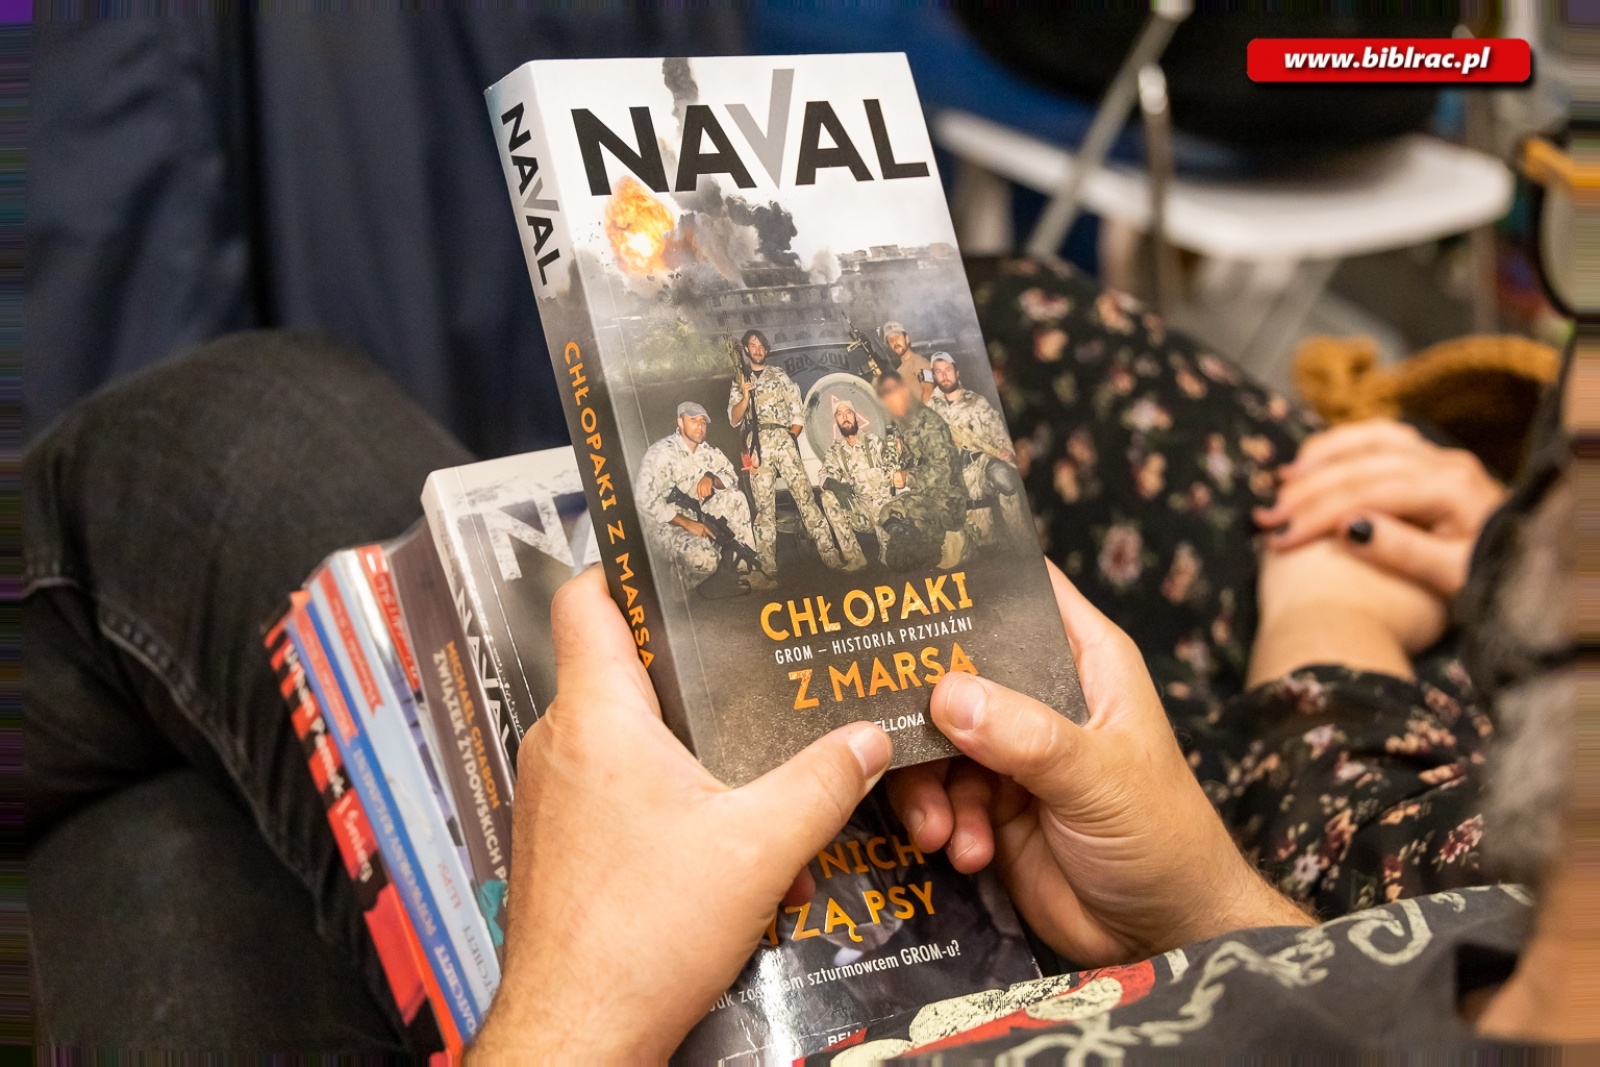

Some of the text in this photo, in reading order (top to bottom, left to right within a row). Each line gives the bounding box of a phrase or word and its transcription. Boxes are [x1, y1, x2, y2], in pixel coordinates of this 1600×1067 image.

[571, 69, 931, 197] NAVAL
[500, 102, 561, 287] NAVAL
[564, 340, 656, 670] CHŁOPAKI Z MARSA
[759, 571, 974, 642] CHŁOPAKI
[774, 645, 814, 665] GROM
[831, 629, 896, 655] HISTORIA
[900, 615, 973, 644] PRZYJAŹNI
[432, 648, 466, 736] ZWIĄZEK
[446, 640, 476, 725] MICHAEL
[787, 641, 980, 711] Z MARSA
[861, 880, 936, 925] PSY
[806, 958, 900, 987] szturmowcem
[901, 939, 962, 966] GROM-u?
